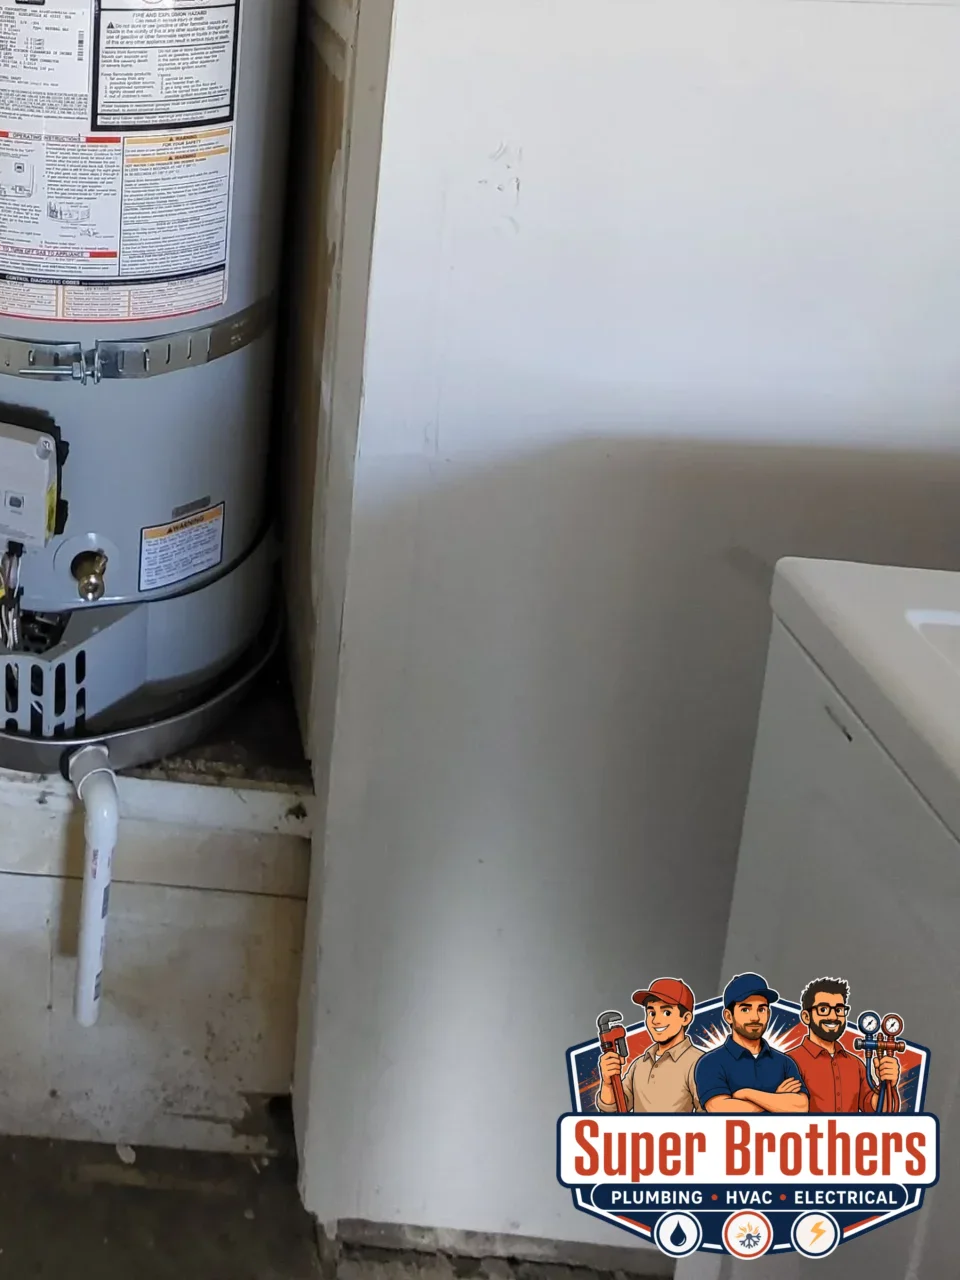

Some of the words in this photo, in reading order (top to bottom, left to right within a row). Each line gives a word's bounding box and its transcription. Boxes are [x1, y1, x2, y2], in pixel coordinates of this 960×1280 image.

[13, 132, 42, 140] OPERATING
[6, 274, 29, 282] CONTROL
[173, 516, 204, 531] WARNING
